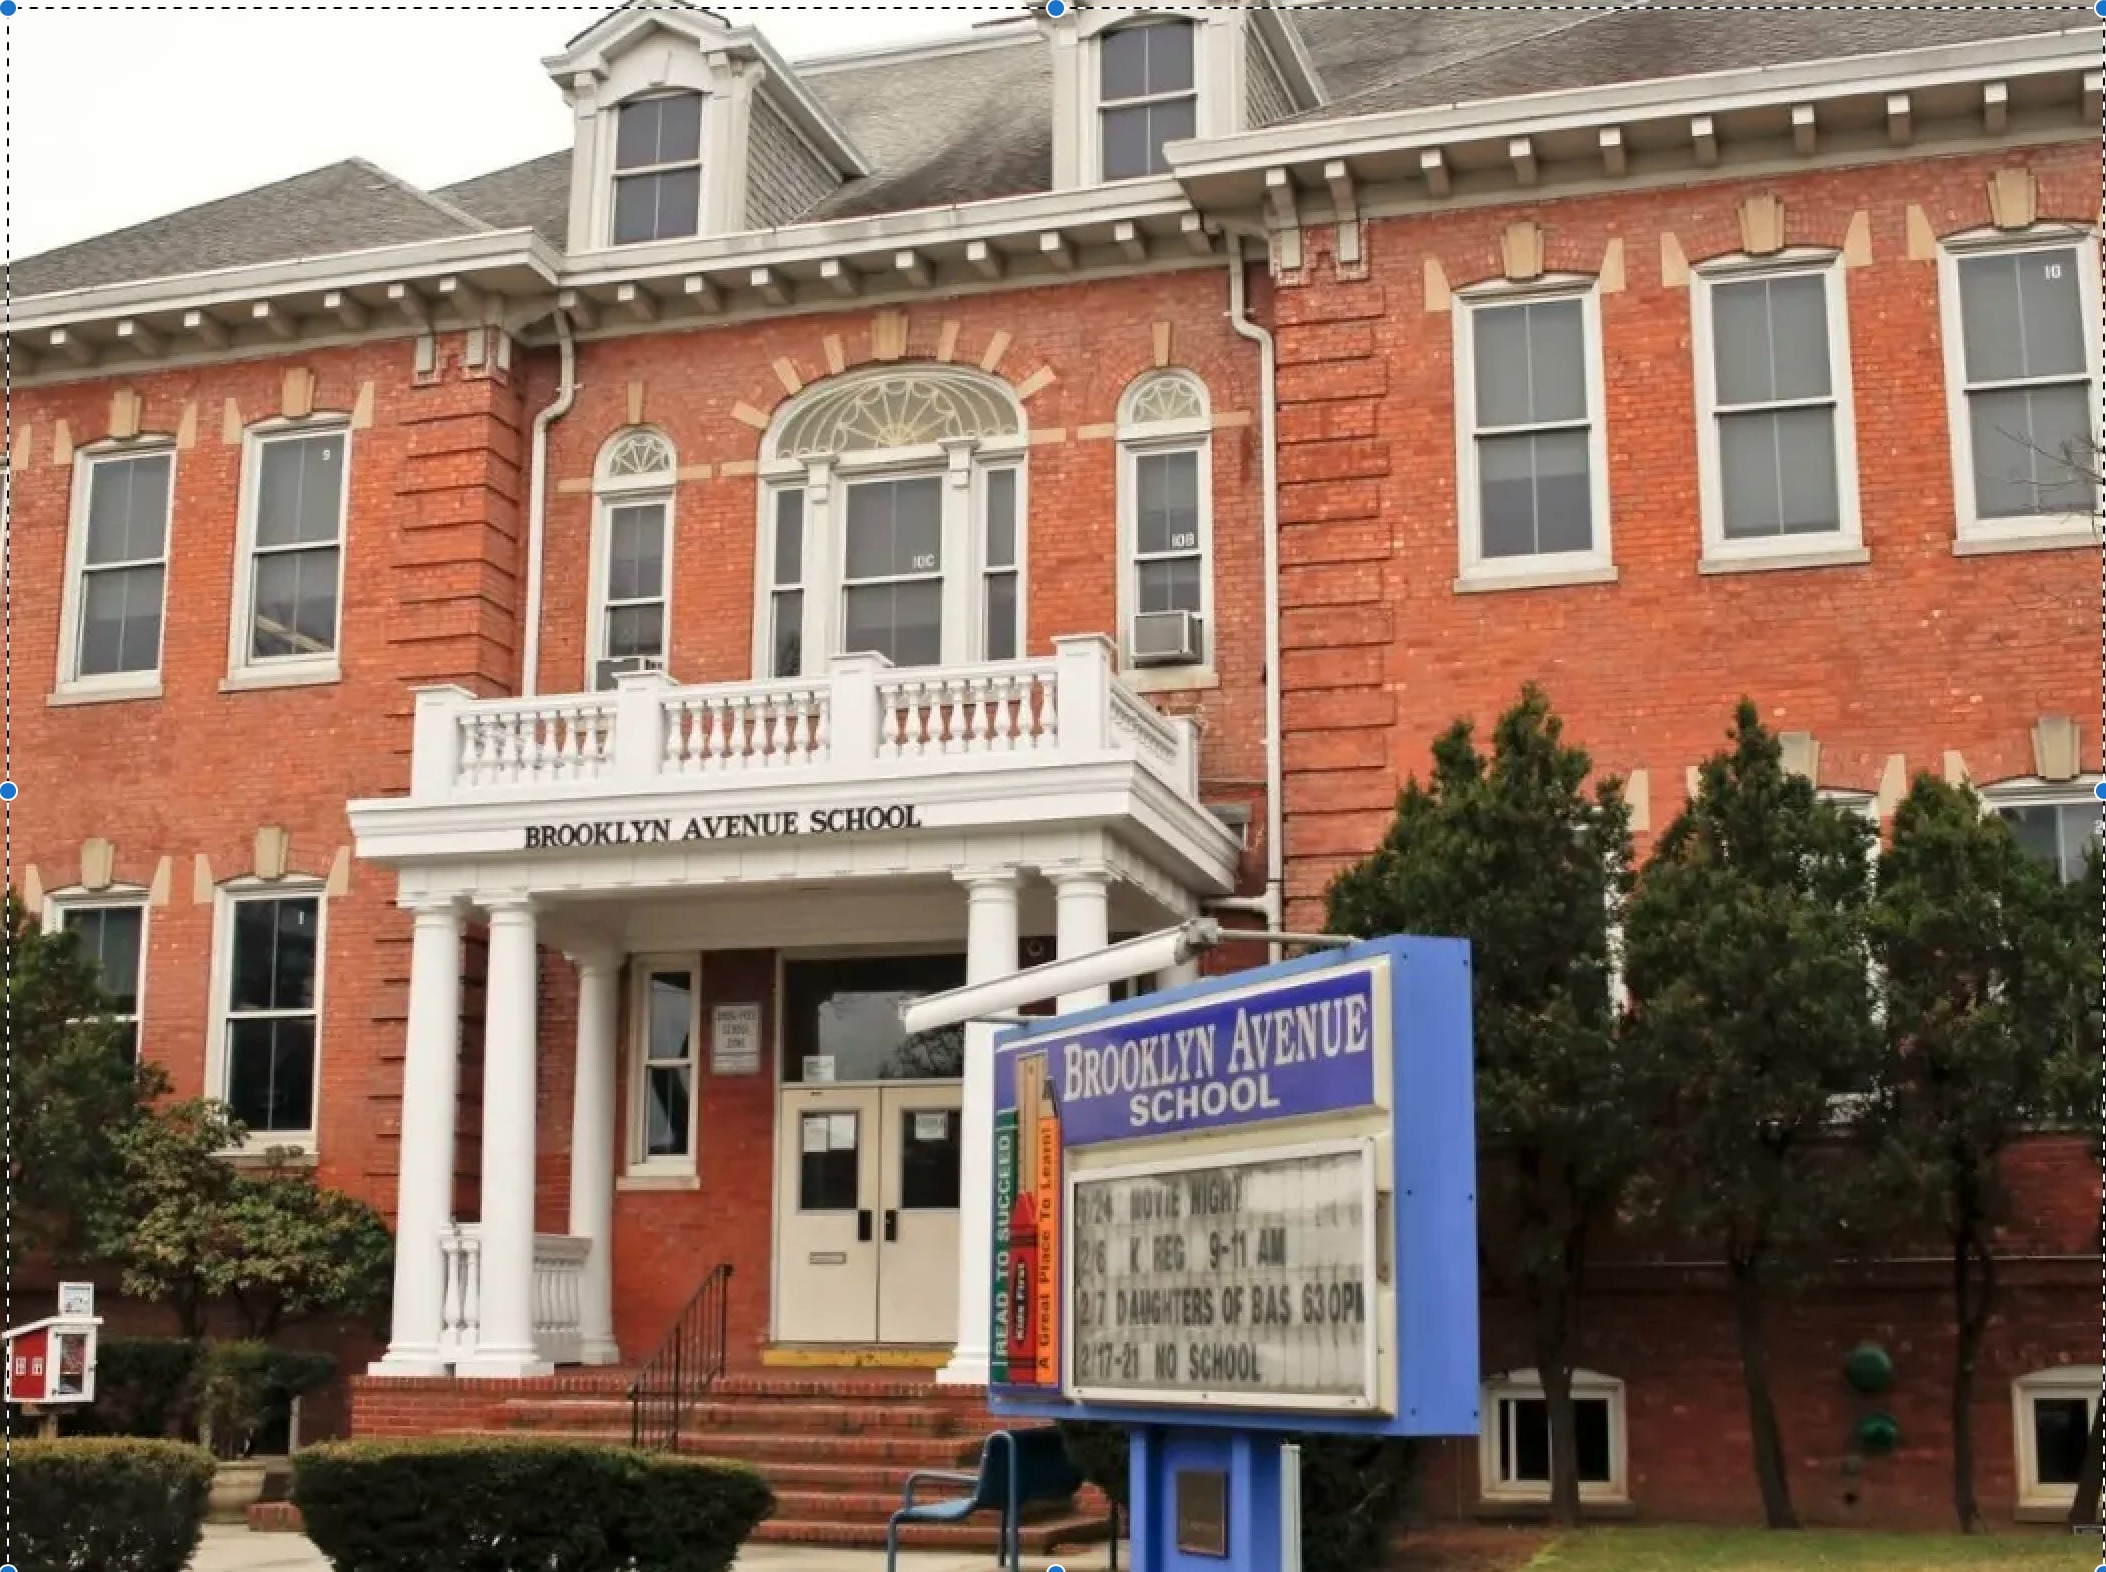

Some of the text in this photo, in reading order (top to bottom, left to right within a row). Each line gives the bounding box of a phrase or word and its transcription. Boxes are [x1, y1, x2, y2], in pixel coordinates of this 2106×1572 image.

[2044, 264, 2062, 280] 10
[525, 804, 922, 849] BROOKLYN AVENUE SCHOOL
[1063, 993, 1368, 1102] BROOKLYN AVENUE
[1129, 1073, 1281, 1127] SCHOOL
[1039, 1197, 1051, 1222] To
[1190, 1174, 1242, 1216] NIGHT
[996, 1134, 1011, 1357] READ TO SUCCEED
[1039, 1229, 1050, 1284] Place
[1129, 1235, 1142, 1273] K
[1153, 1233, 1186, 1272] REG
[1209, 1230, 1247, 1270] 9-11
[1257, 1226, 1286, 1266] AM
[1039, 1293, 1050, 1347] Great
[1116, 1286, 1214, 1326] DAUGHTERS
[1222, 1285, 1244, 1325] OF
[1251, 1284, 1291, 1325] BAS
[1038, 1357, 1050, 1369] A
[1155, 1342, 1178, 1380] NO
[1189, 1341, 1262, 1383] SCHOOL
